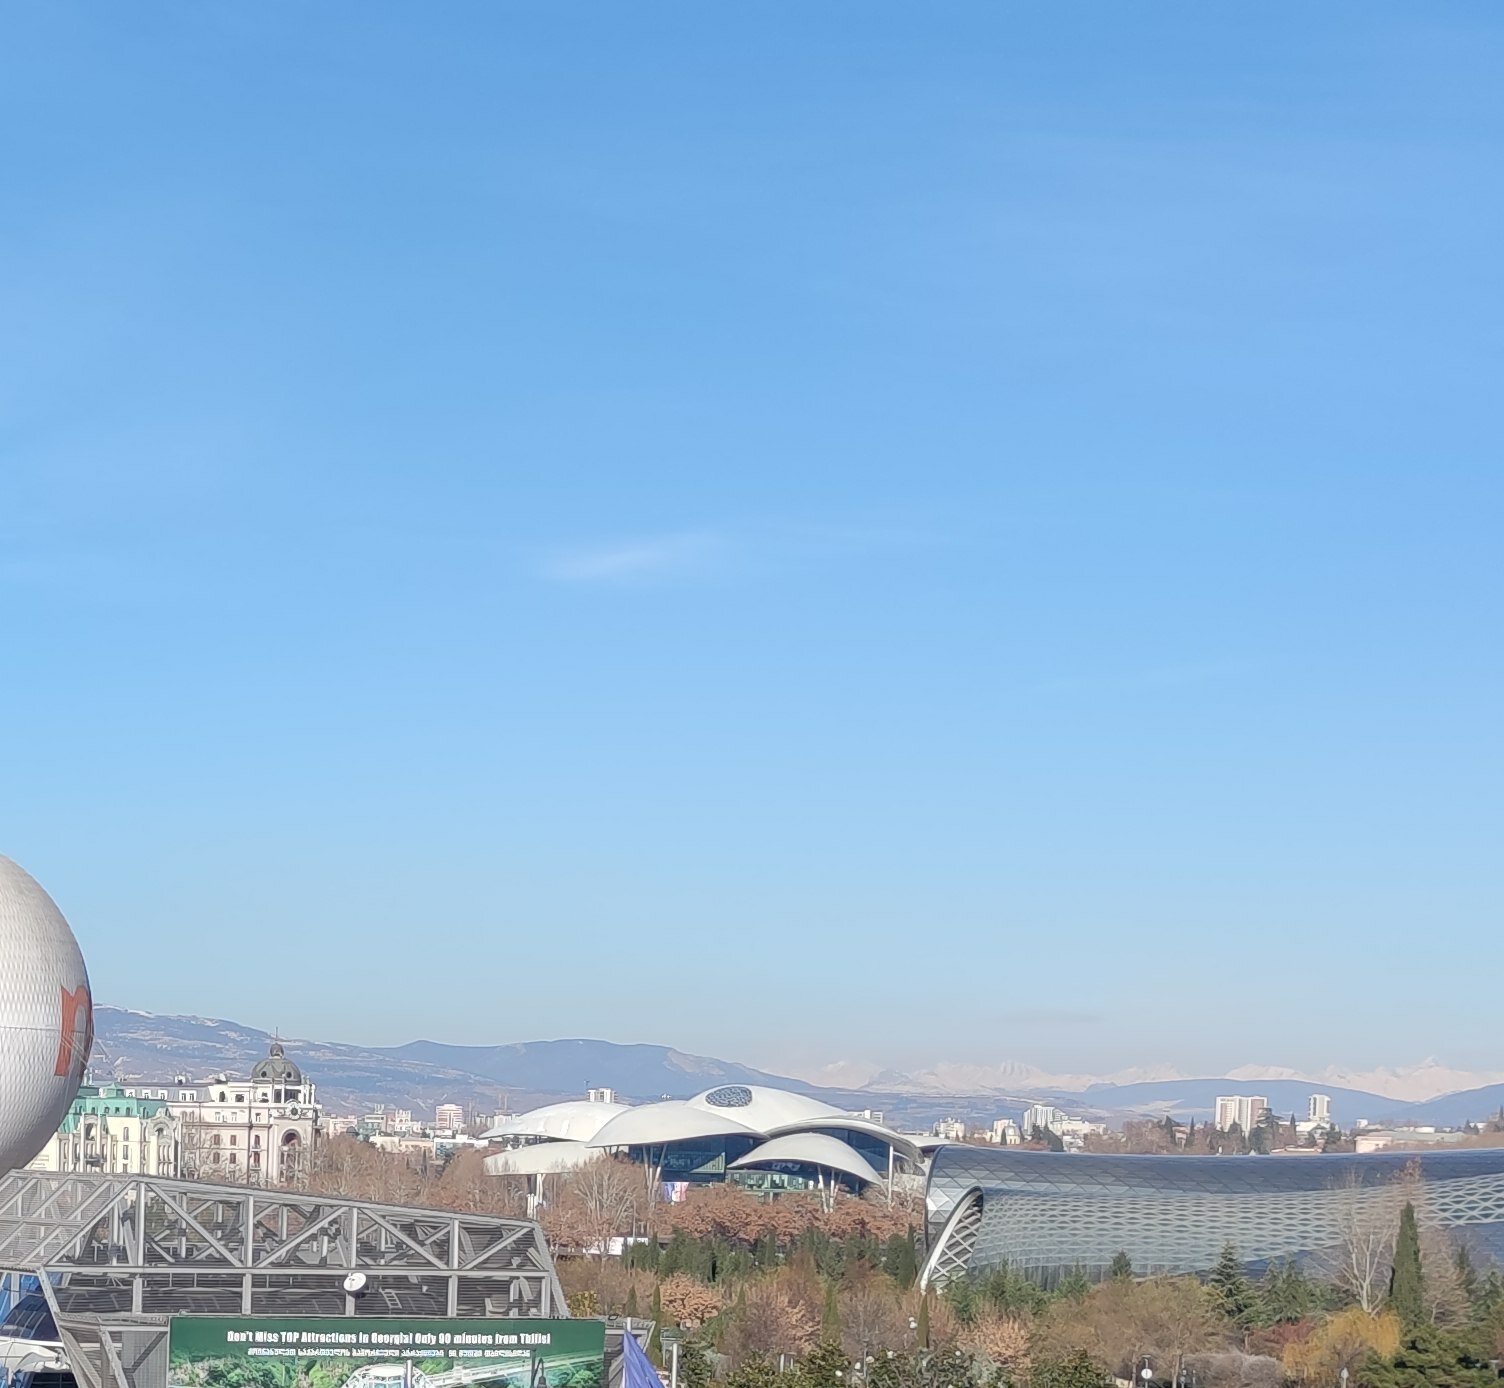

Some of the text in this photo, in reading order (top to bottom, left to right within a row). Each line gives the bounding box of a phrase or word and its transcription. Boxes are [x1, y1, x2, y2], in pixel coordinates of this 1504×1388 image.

[227, 1330, 253, 1343] Don't
[255, 1331, 279, 1343] Miss
[281, 1332, 298, 1343] TOP
[301, 1331, 356, 1344] Attractions
[358, 1332, 369, 1344] in
[415, 1333, 437, 1346] Only
[439, 1333, 451, 1345] 90
[454, 1332, 493, 1345] minutes
[495, 1333, 518, 1345] from
[520, 1333, 550, 1345] Tbilisi
